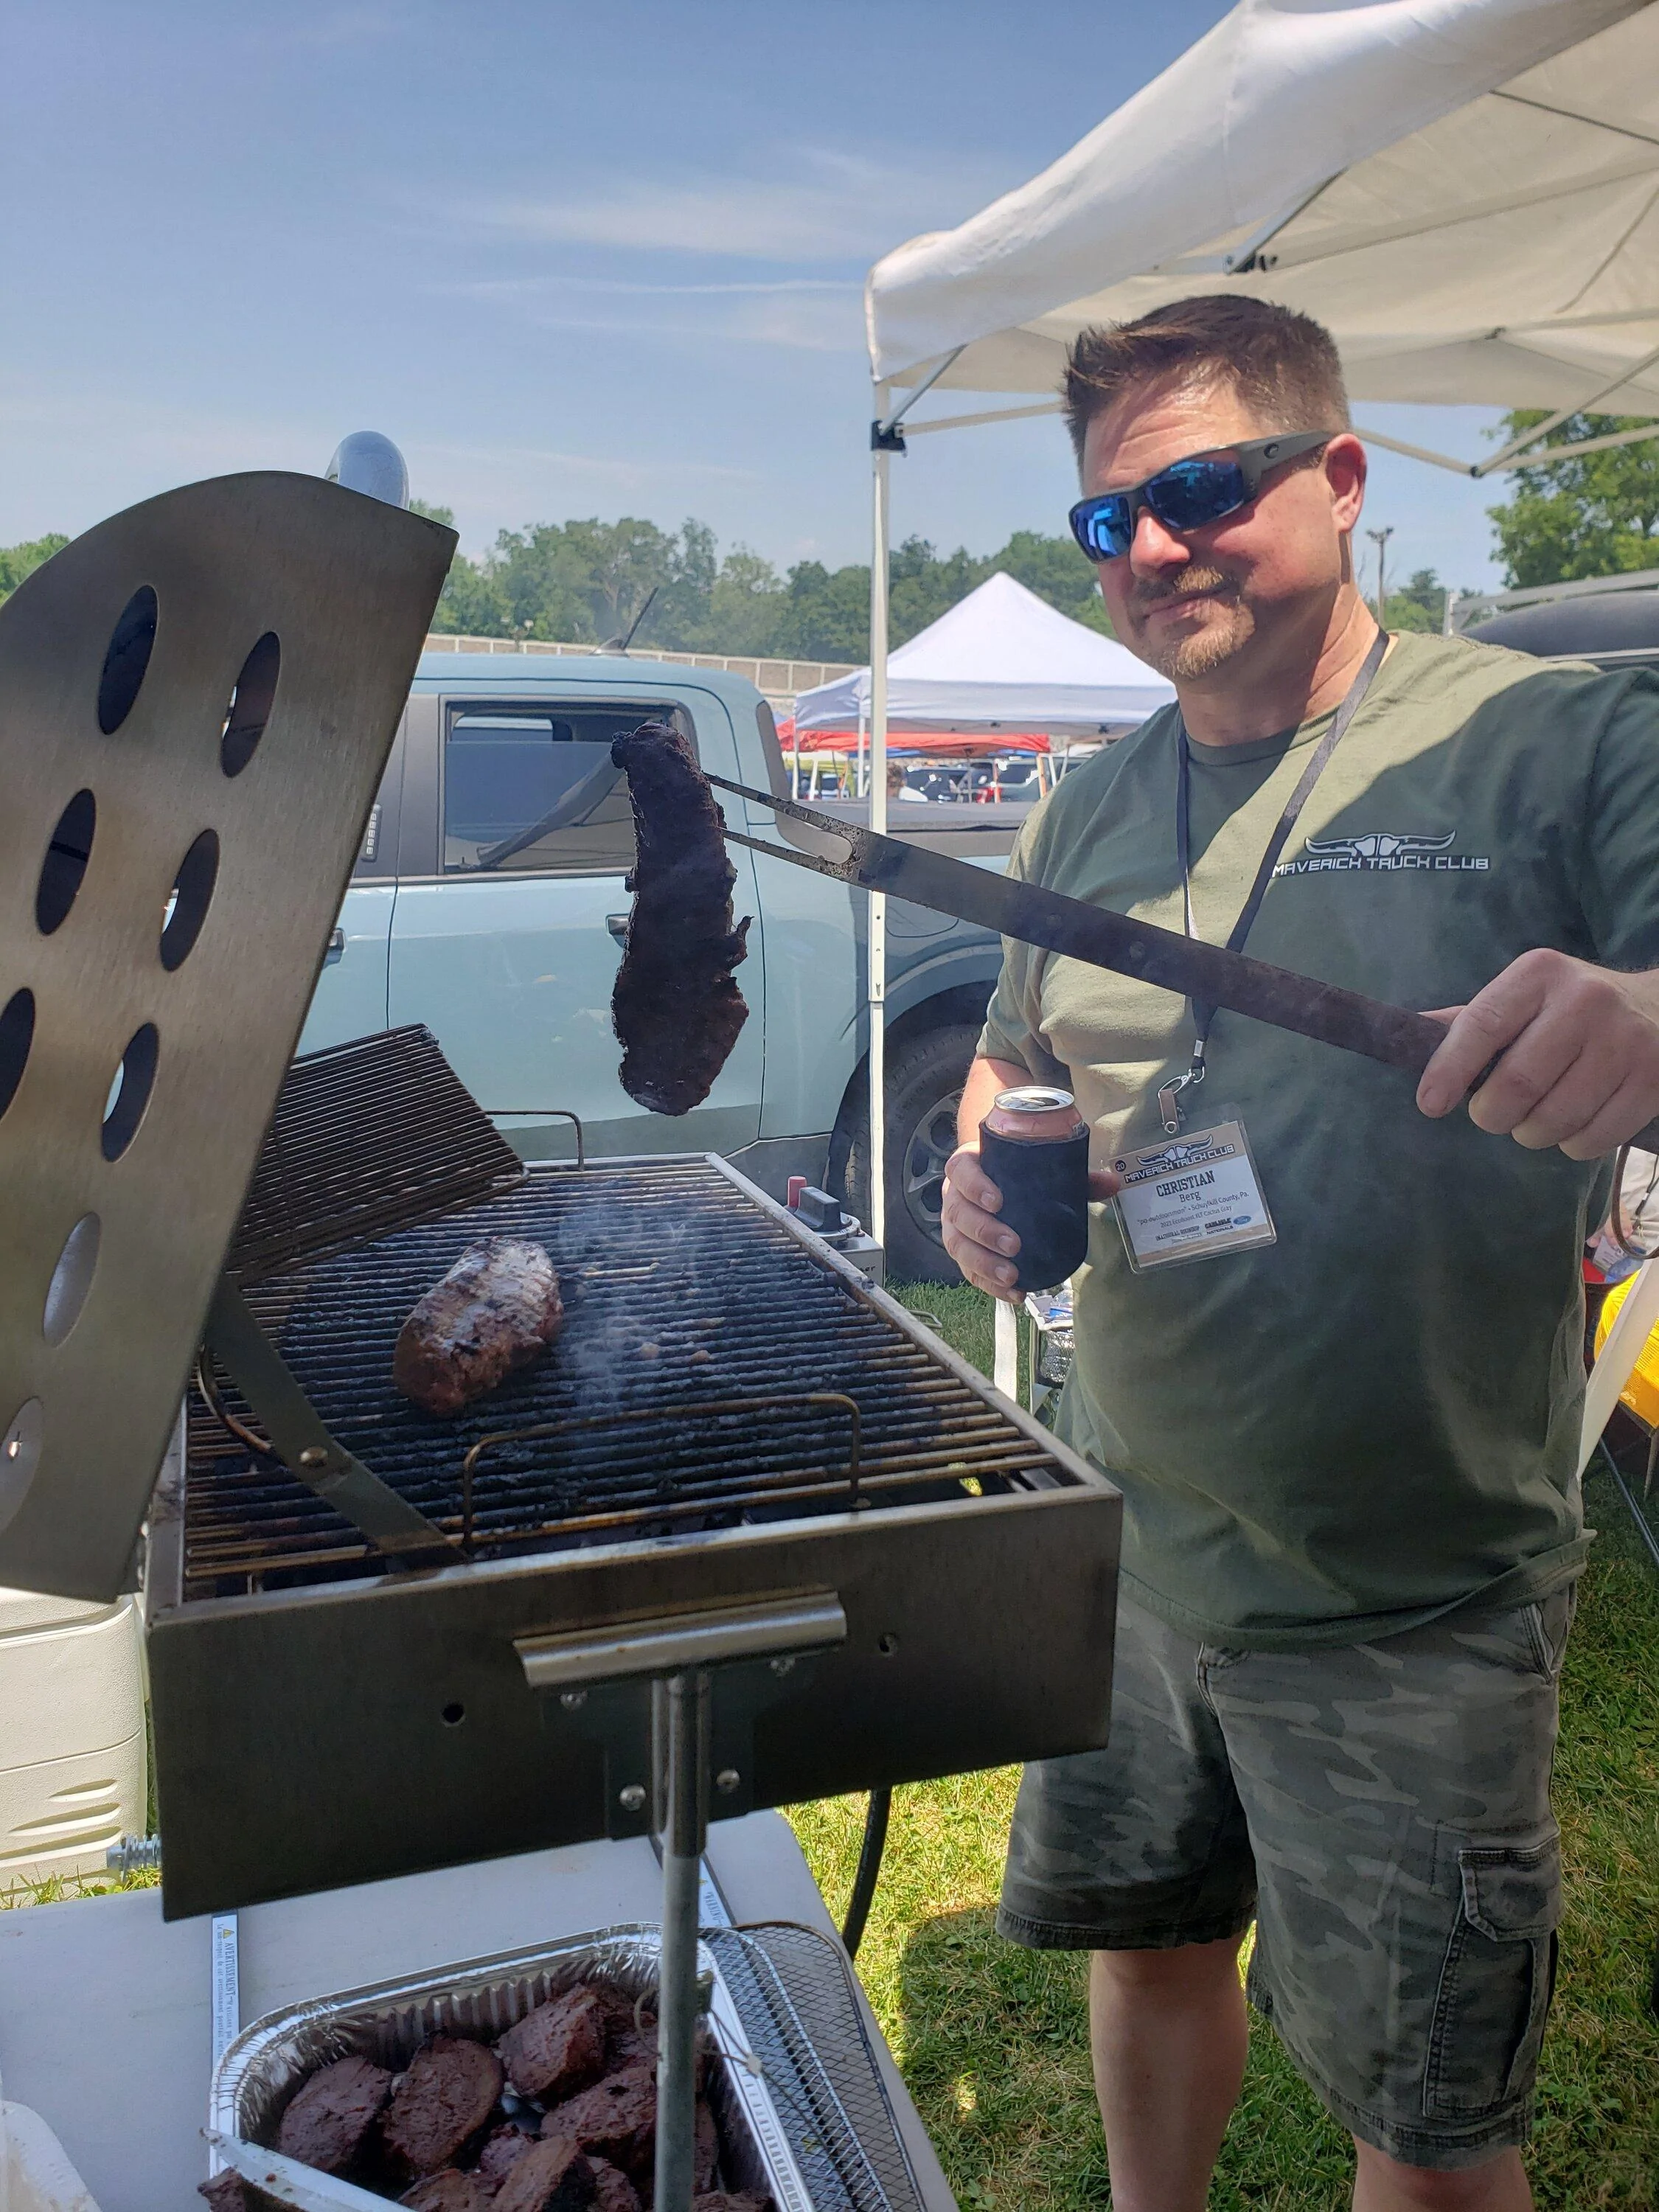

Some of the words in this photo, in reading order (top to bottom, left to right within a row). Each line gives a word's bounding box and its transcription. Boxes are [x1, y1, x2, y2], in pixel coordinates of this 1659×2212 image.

[1271, 858, 1361, 877] MAVERICK
[1366, 855, 1430, 870] TRUCK
[1435, 856, 1489, 870] CLUB
[1125, 1163, 1173, 1183] MAVERICK
[1173, 1153, 1207, 1167] TRUCK
[1207, 1144, 1234, 1158] CLUB
[1156, 1170, 1215, 1197] CHRISTIAN
[1179, 1191, 1201, 1203] Berg
[1219, 1192, 1239, 1205] County,
[1239, 1191, 1249, 1201] Pa.
